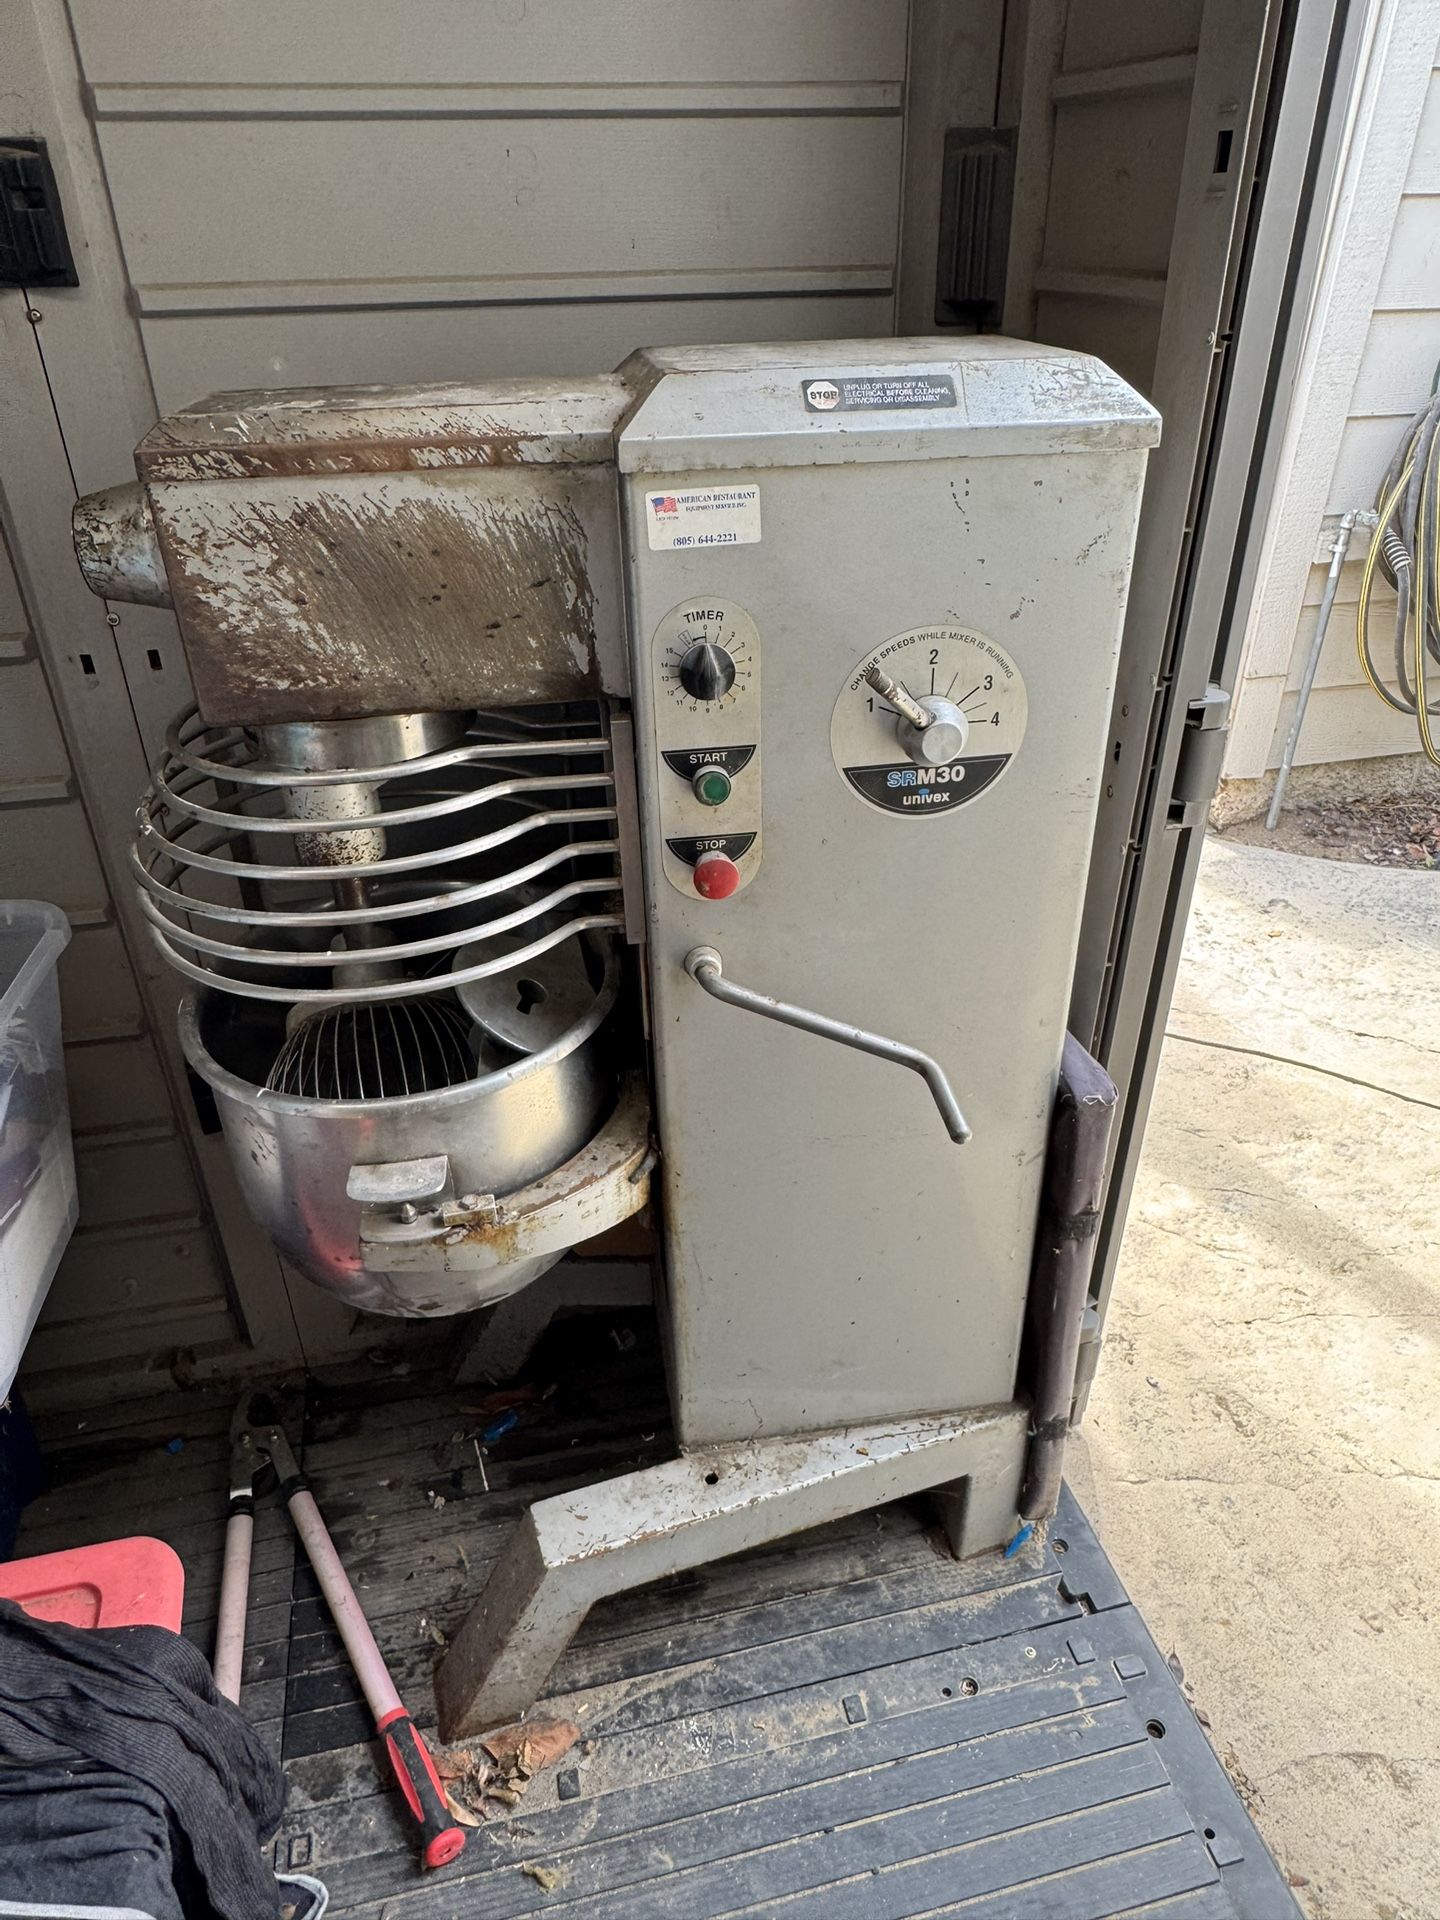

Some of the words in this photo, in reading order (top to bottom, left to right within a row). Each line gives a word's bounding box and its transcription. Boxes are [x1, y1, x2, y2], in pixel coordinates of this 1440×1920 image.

[843, 383, 871, 391] UNPLUG
[883, 382, 902, 390] TURN
[810, 391, 838, 400] STOP
[844, 390, 885, 398] ELECTRICAL
[886, 389, 913, 397] BEFORE
[845, 397, 883, 405] SERVICING
[894, 395, 940, 403] DISASSEMBLY
[676, 494, 712, 504] AMERICAN
[712, 491, 756, 502] RESTAURANT
[685, 504, 714, 512] EQUIPMENT
[673, 536, 696, 547] (805)
[698, 533, 737, 544] 644-2221
[683, 610, 725, 623] TIMER
[850, 656, 881, 691] CHANGE
[880, 635, 916, 660] SPEEDS
[917, 631, 946, 642] WHILE
[949, 631, 977, 646] MIXER
[976, 640, 986, 650] IS
[985, 646, 1014, 679] RUNNING
[929, 648, 939, 665] 2
[983, 674, 993, 691] 3
[866, 697, 874, 713] 1
[990, 711, 1000, 727] 4
[689, 752, 728, 764] START
[887, 765, 965, 788] SRM30
[903, 789, 950, 806] univex
[696, 839, 727, 850] STOP
